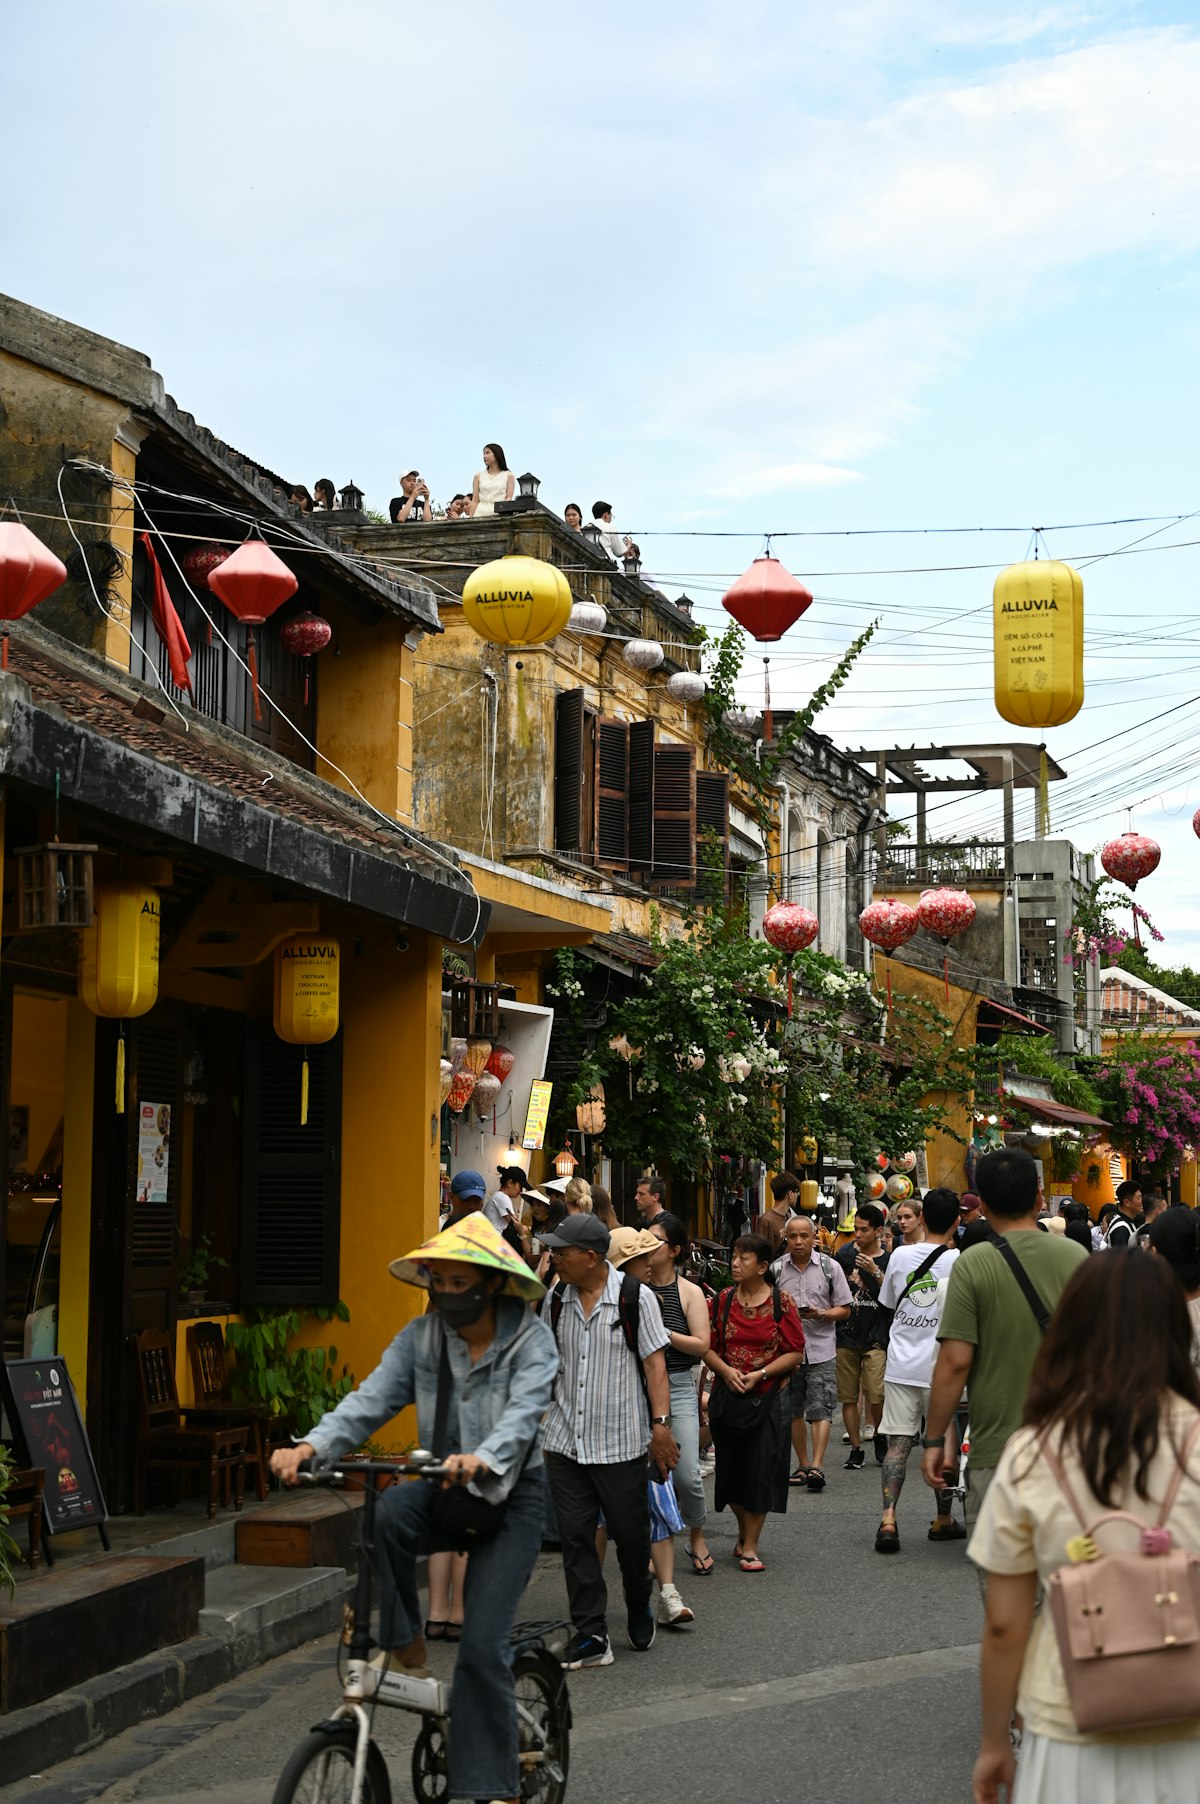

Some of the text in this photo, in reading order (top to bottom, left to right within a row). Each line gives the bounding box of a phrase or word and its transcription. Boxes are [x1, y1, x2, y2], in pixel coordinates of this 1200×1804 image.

[476, 590, 534, 604] ALLUVIA
[1001, 599, 1059, 614] ALLUVIA
[1010, 655, 1045, 665] VIỆT NAM
[283, 947, 336, 959] ALLUVIA
[895, 1311, 938, 1327] Malbo
